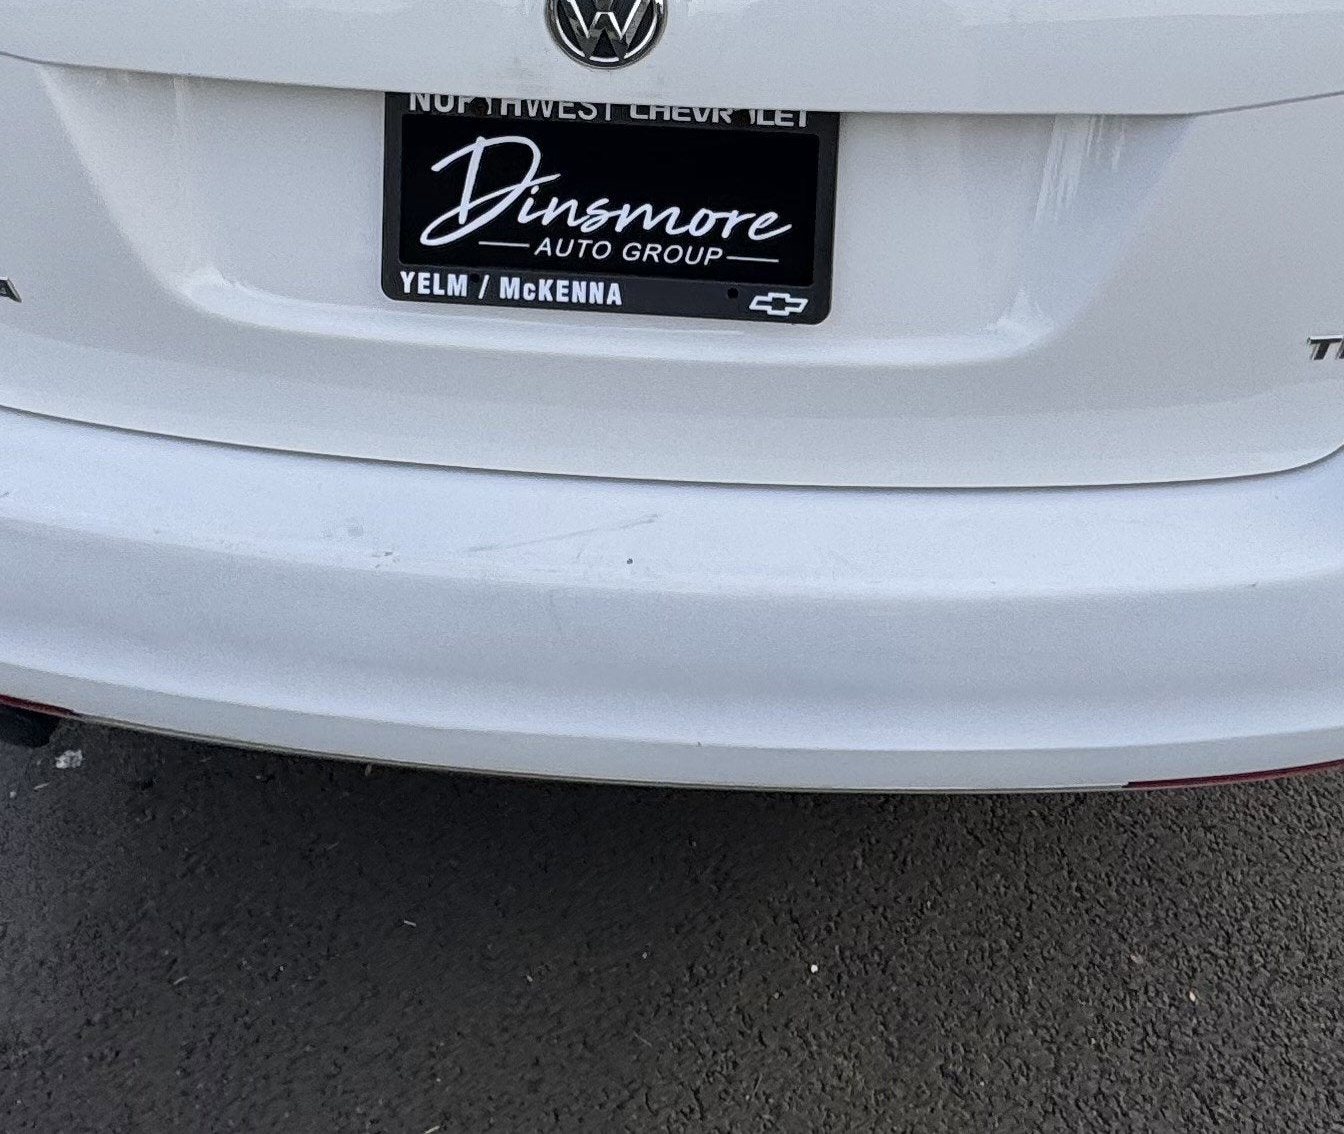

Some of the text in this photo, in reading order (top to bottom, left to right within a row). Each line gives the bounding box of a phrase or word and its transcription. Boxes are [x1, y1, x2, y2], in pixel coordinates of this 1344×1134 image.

[419, 135, 793, 247] Dinsmore
[533, 236, 724, 266] AUTO GROUP
[399, 270, 623, 306] YELM / McKENNA
